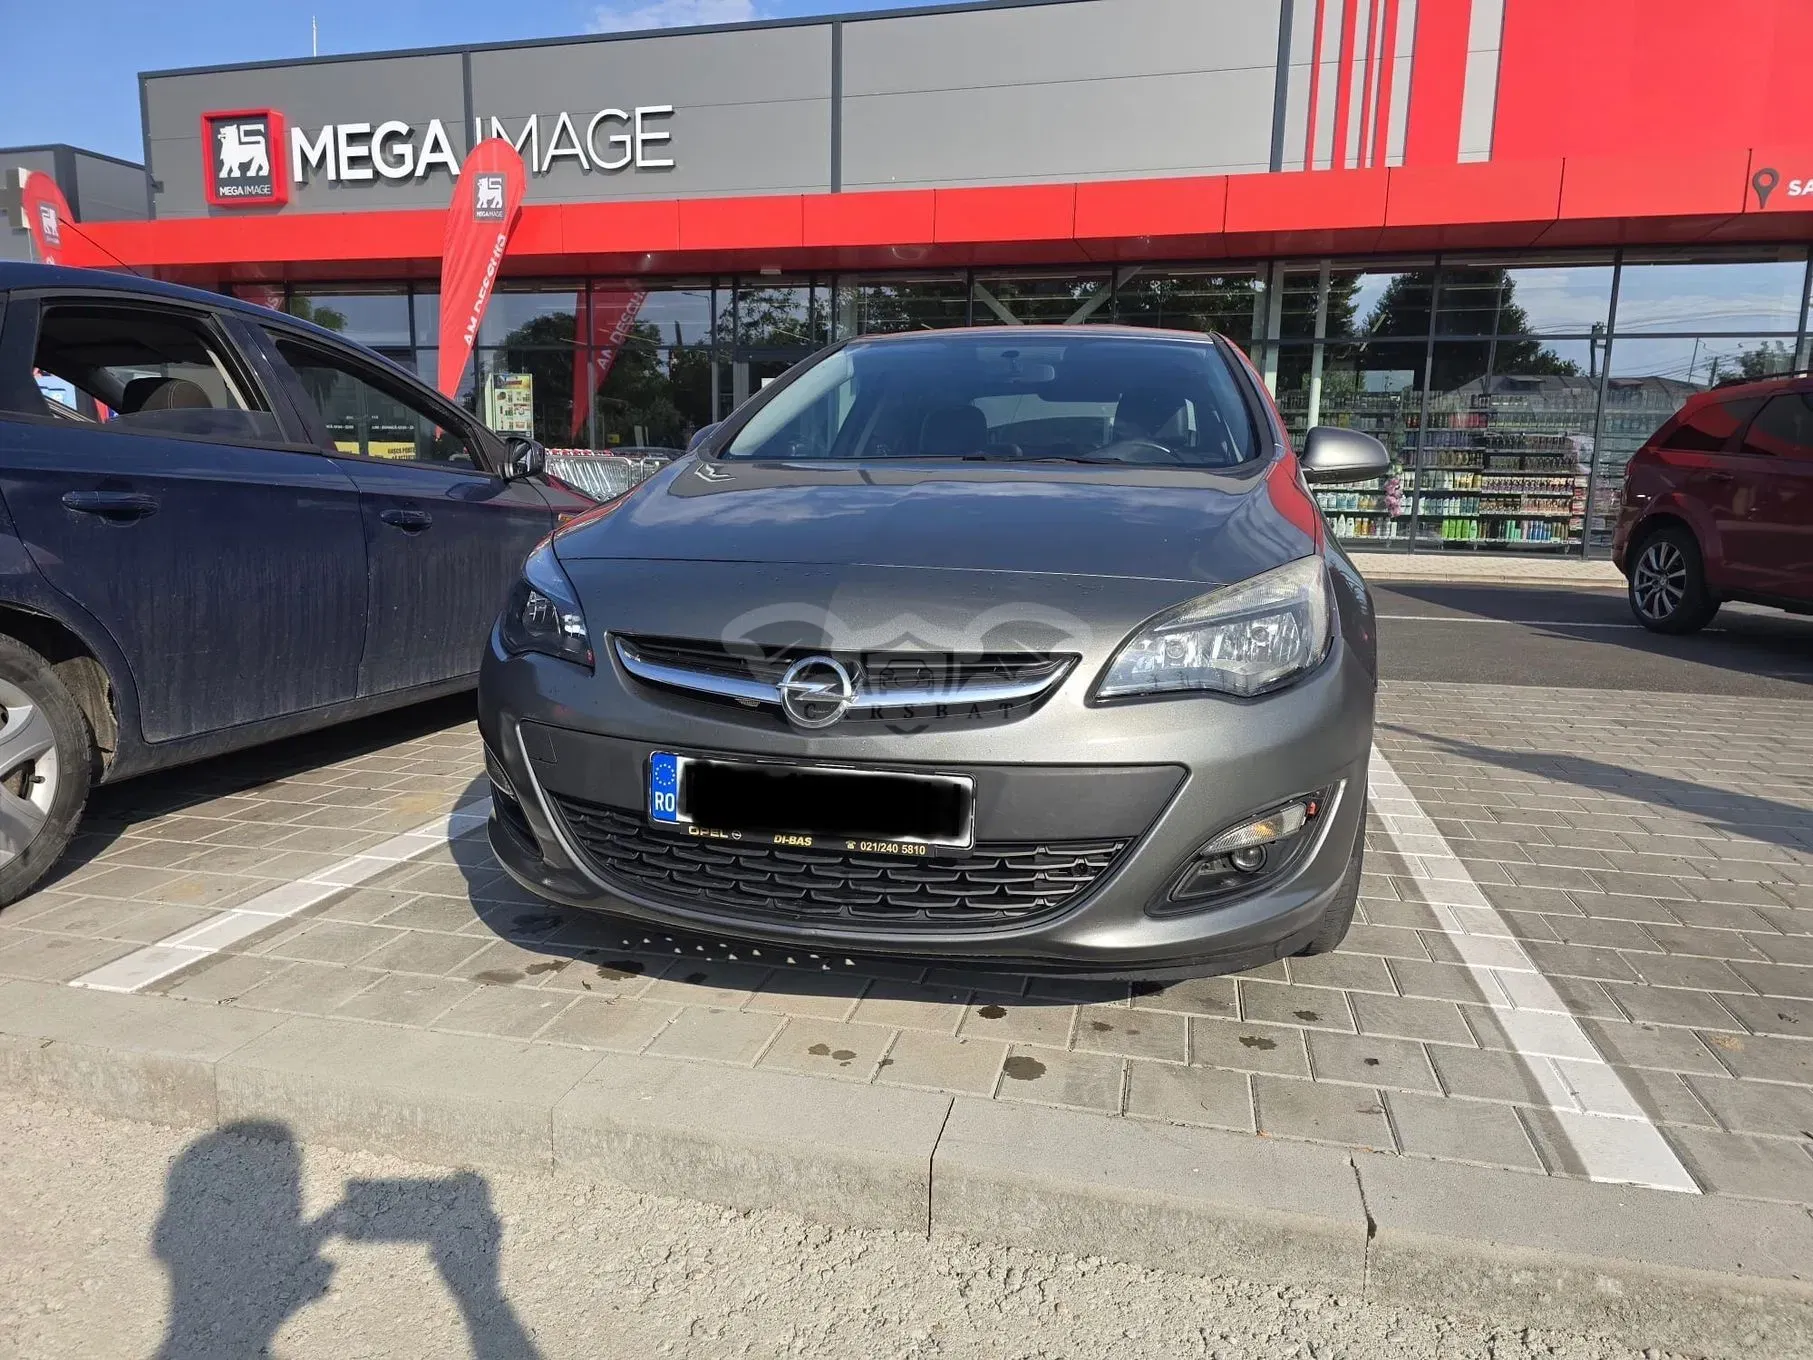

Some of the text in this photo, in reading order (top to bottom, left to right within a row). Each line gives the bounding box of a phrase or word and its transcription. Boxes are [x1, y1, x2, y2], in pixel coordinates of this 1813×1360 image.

[291, 118, 461, 183] MEGA
[219, 184, 271, 196] MEGA IMAGE
[464, 316, 478, 346] AM
[654, 791, 675, 812] RO
[688, 826, 926, 855] OPEL DI-BAS 021/240 5810
